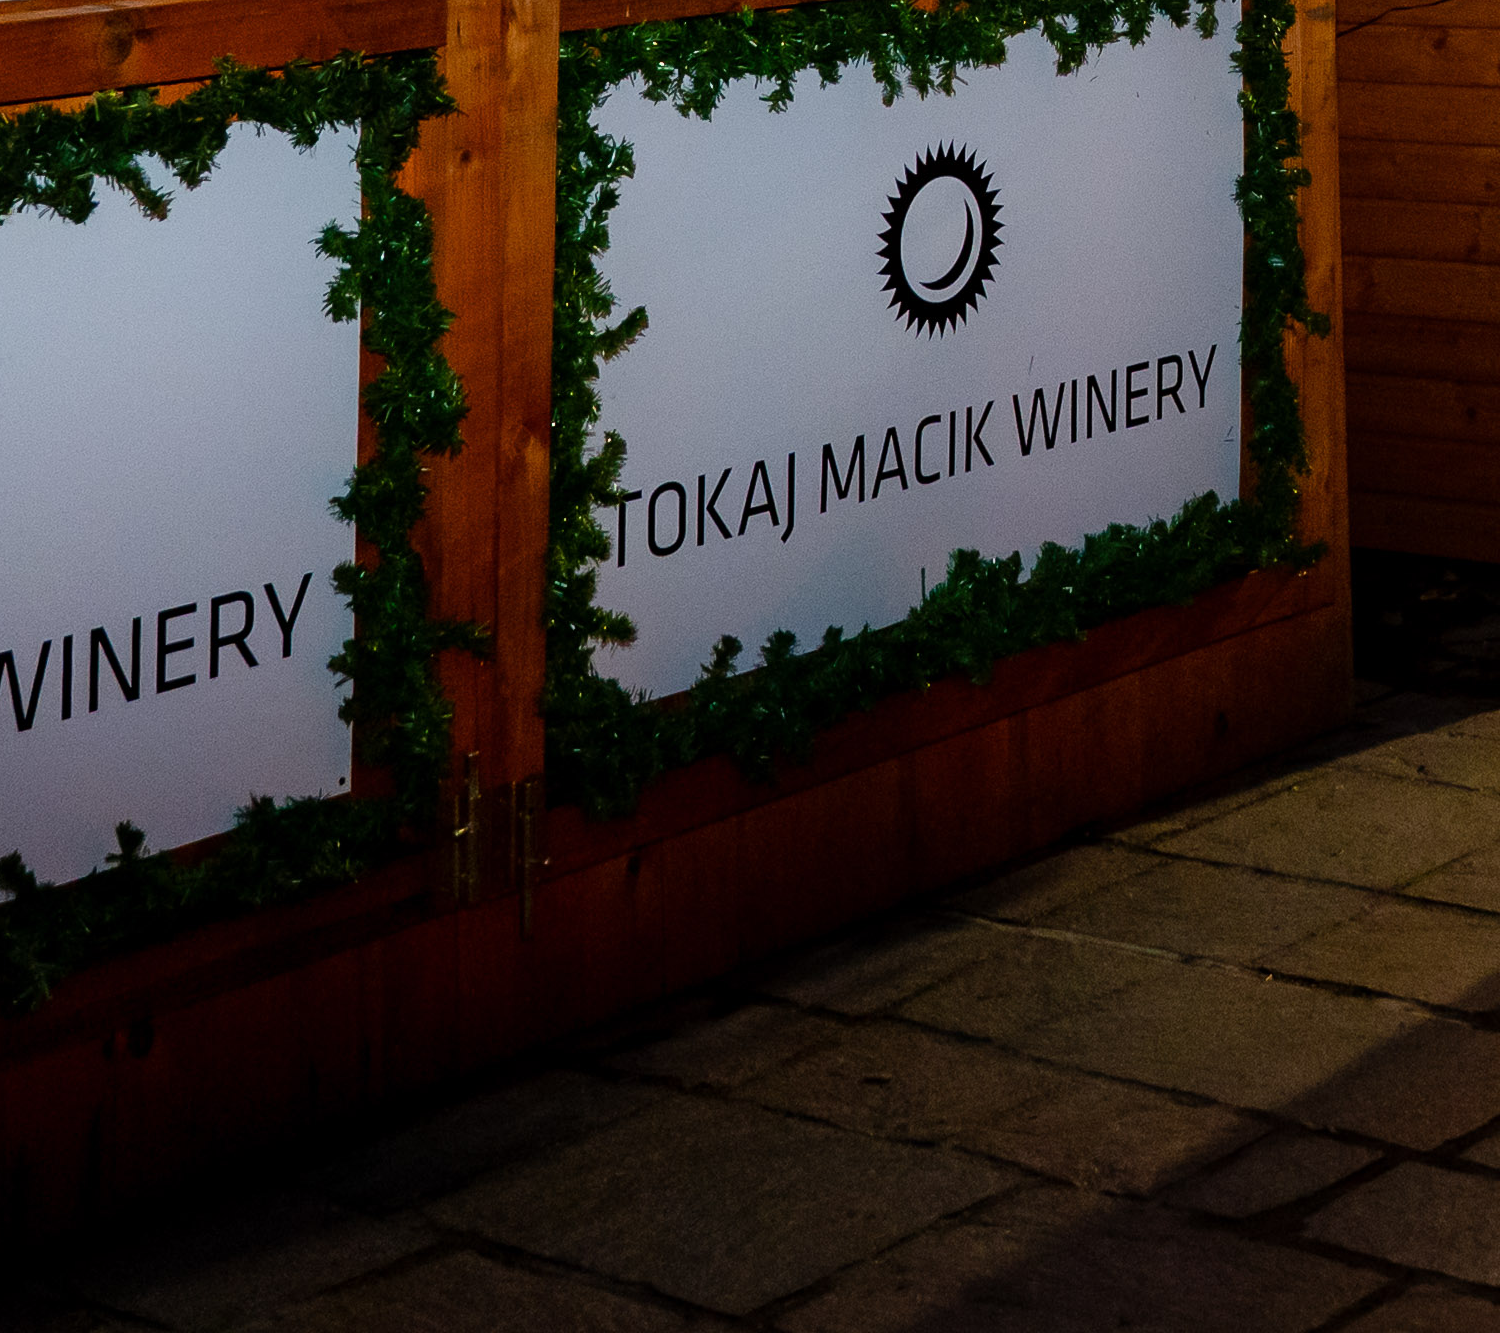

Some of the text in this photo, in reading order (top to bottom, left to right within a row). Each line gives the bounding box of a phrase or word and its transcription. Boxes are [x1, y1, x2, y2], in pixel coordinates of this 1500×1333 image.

[612, 344, 1218, 569] TOKAJ MACIK WINERY
